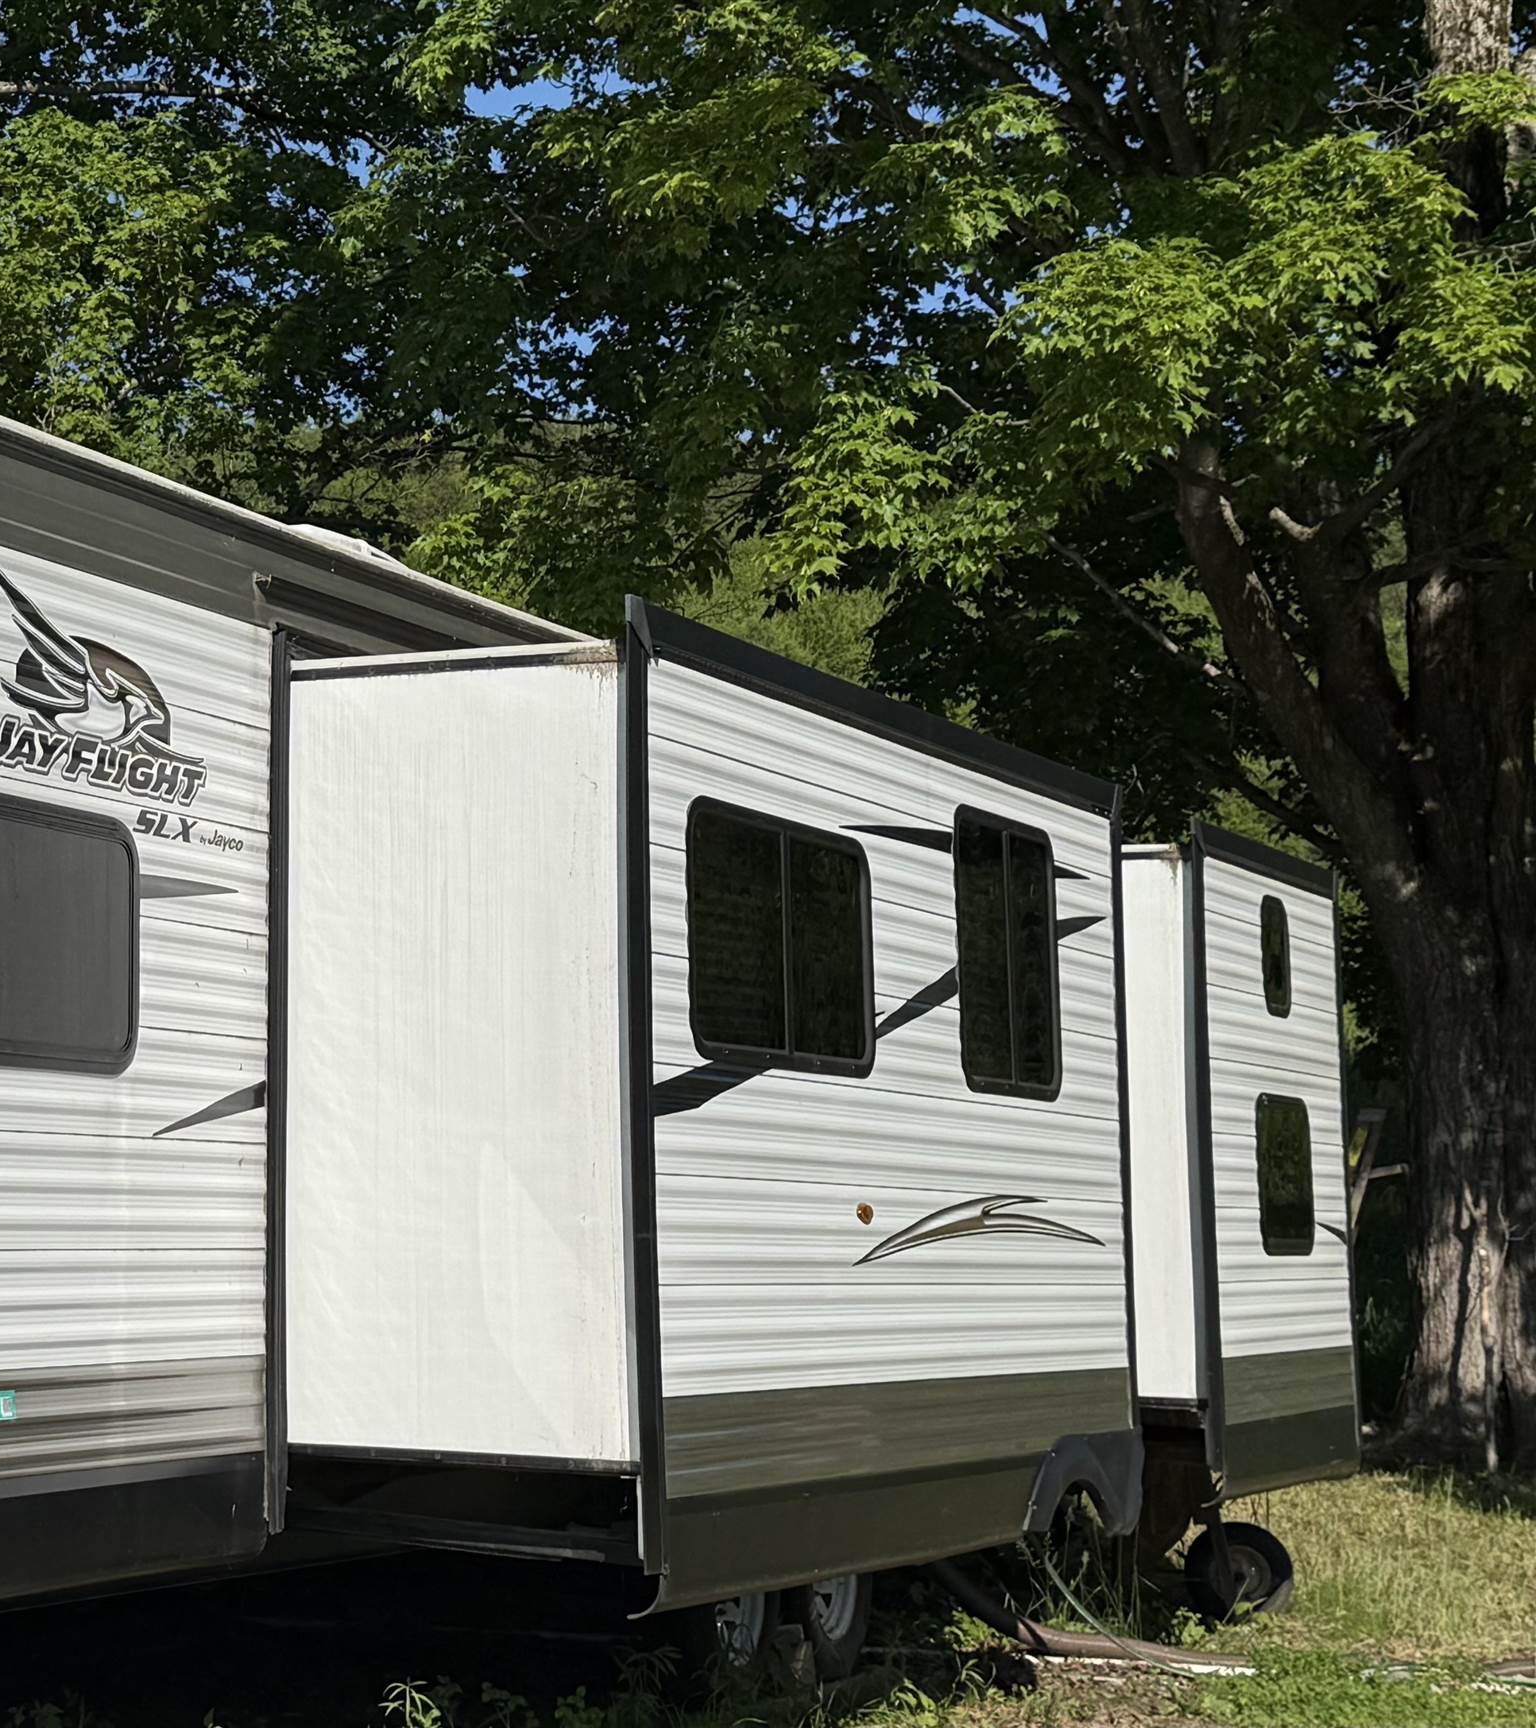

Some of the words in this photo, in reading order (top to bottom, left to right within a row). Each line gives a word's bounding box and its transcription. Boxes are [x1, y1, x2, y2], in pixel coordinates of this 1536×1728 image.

[62, 731, 207, 807] FLIGHT
[133, 809, 198, 843] SLX
[208, 829, 244, 852] Jayco
